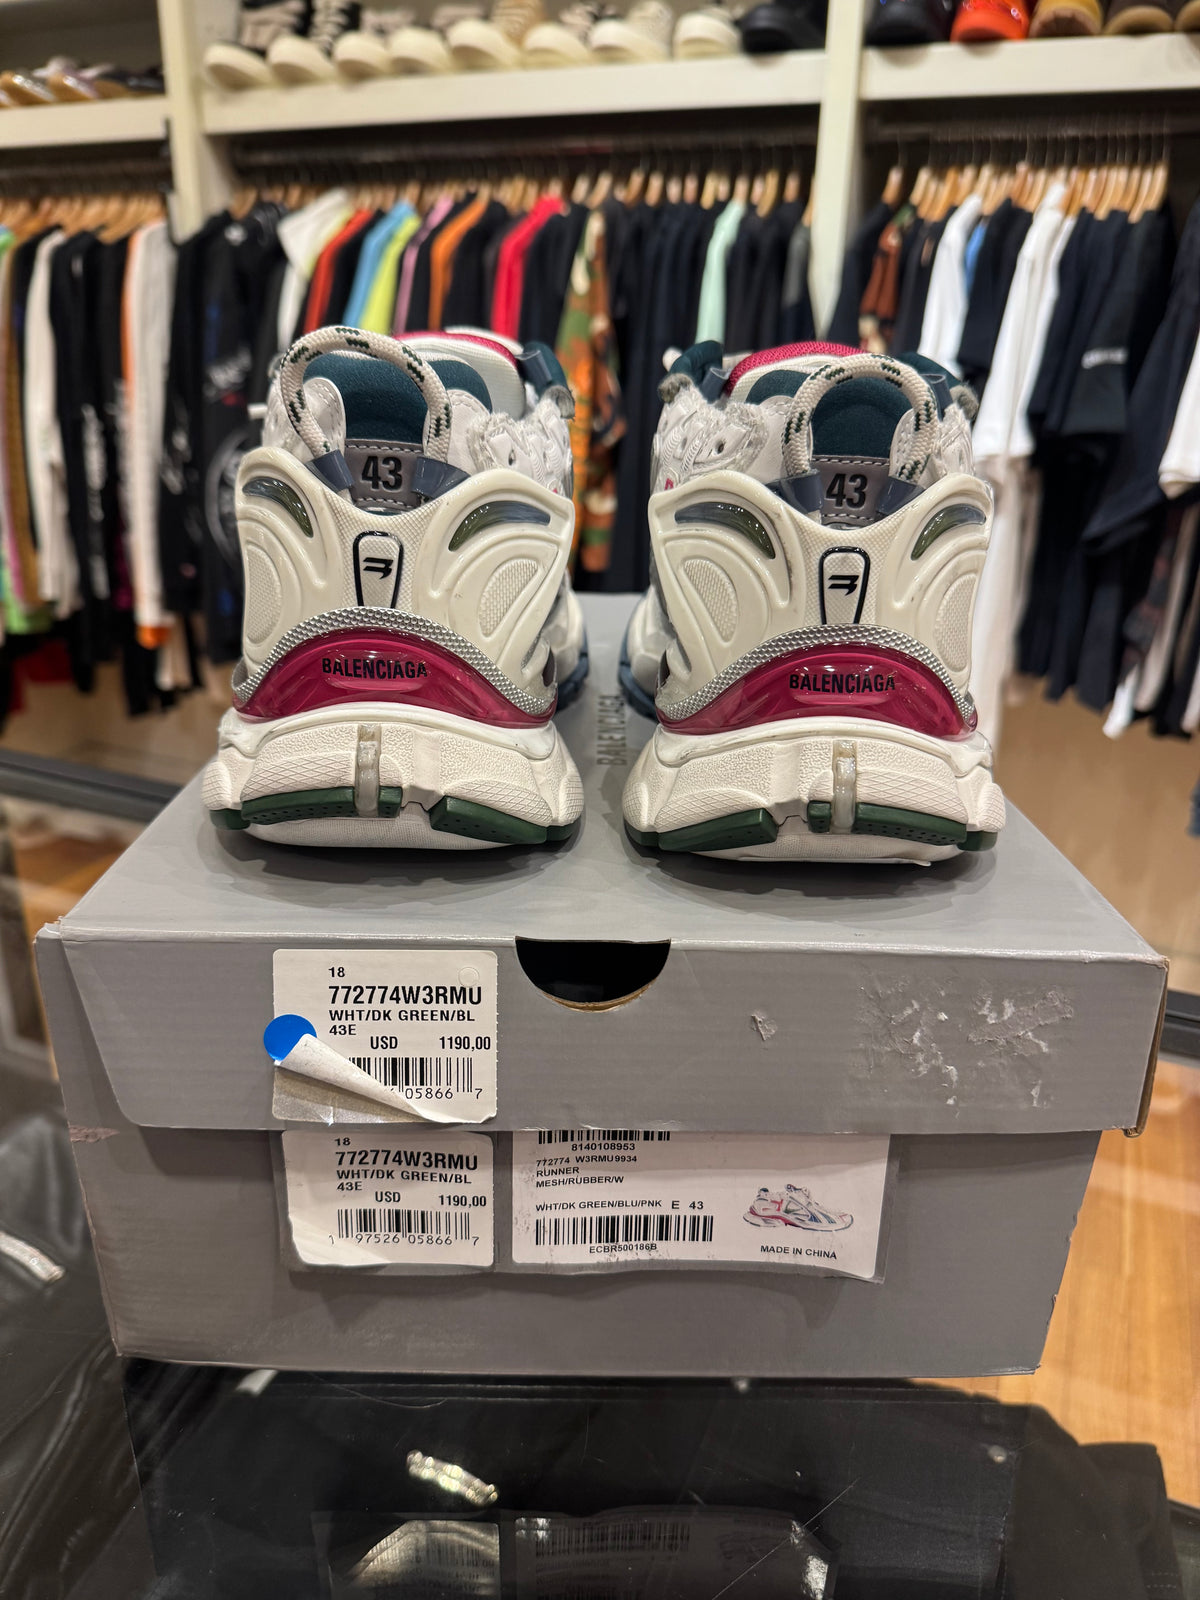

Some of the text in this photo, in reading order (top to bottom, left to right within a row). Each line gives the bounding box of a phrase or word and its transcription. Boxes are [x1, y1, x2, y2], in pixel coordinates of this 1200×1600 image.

[361, 455, 403, 491] 43
[825, 473, 867, 508] 43
[321, 657, 428, 679] BALENCIAGA
[789, 672, 896, 694] BALENCIAGA
[597, 695, 626, 766] BALENCIAGA
[328, 966, 345, 978] 18
[328, 985, 482, 1005] 772774W3RMU
[329, 1009, 476, 1022] WHT/DK GREEN/BL
[329, 1024, 357, 1036] 43E
[370, 1036, 491, 1052] USD 1190,00
[474, 1088, 483, 1099] 7
[334, 1137, 351, 1146] 18
[571, 1142, 636, 1152] 8140108953
[335, 1150, 478, 1171] 772774W3RMU
[536, 1157, 570, 1167] 772774
[336, 1169, 472, 1185] WHT/DK GREEN/BL
[536, 1166, 580, 1178] RUNNER
[337, 1181, 363, 1192] 43E
[536, 1176, 624, 1188] MESH/RUBBER/W
[375, 1191, 487, 1209] USD 1190,00
[535, 1200, 704, 1212] WHT/DK GREEN/BLU/PNK E 43
[589, 1243, 658, 1254] ECBR500186B
[760, 1245, 838, 1260] MADE IN CHINA
